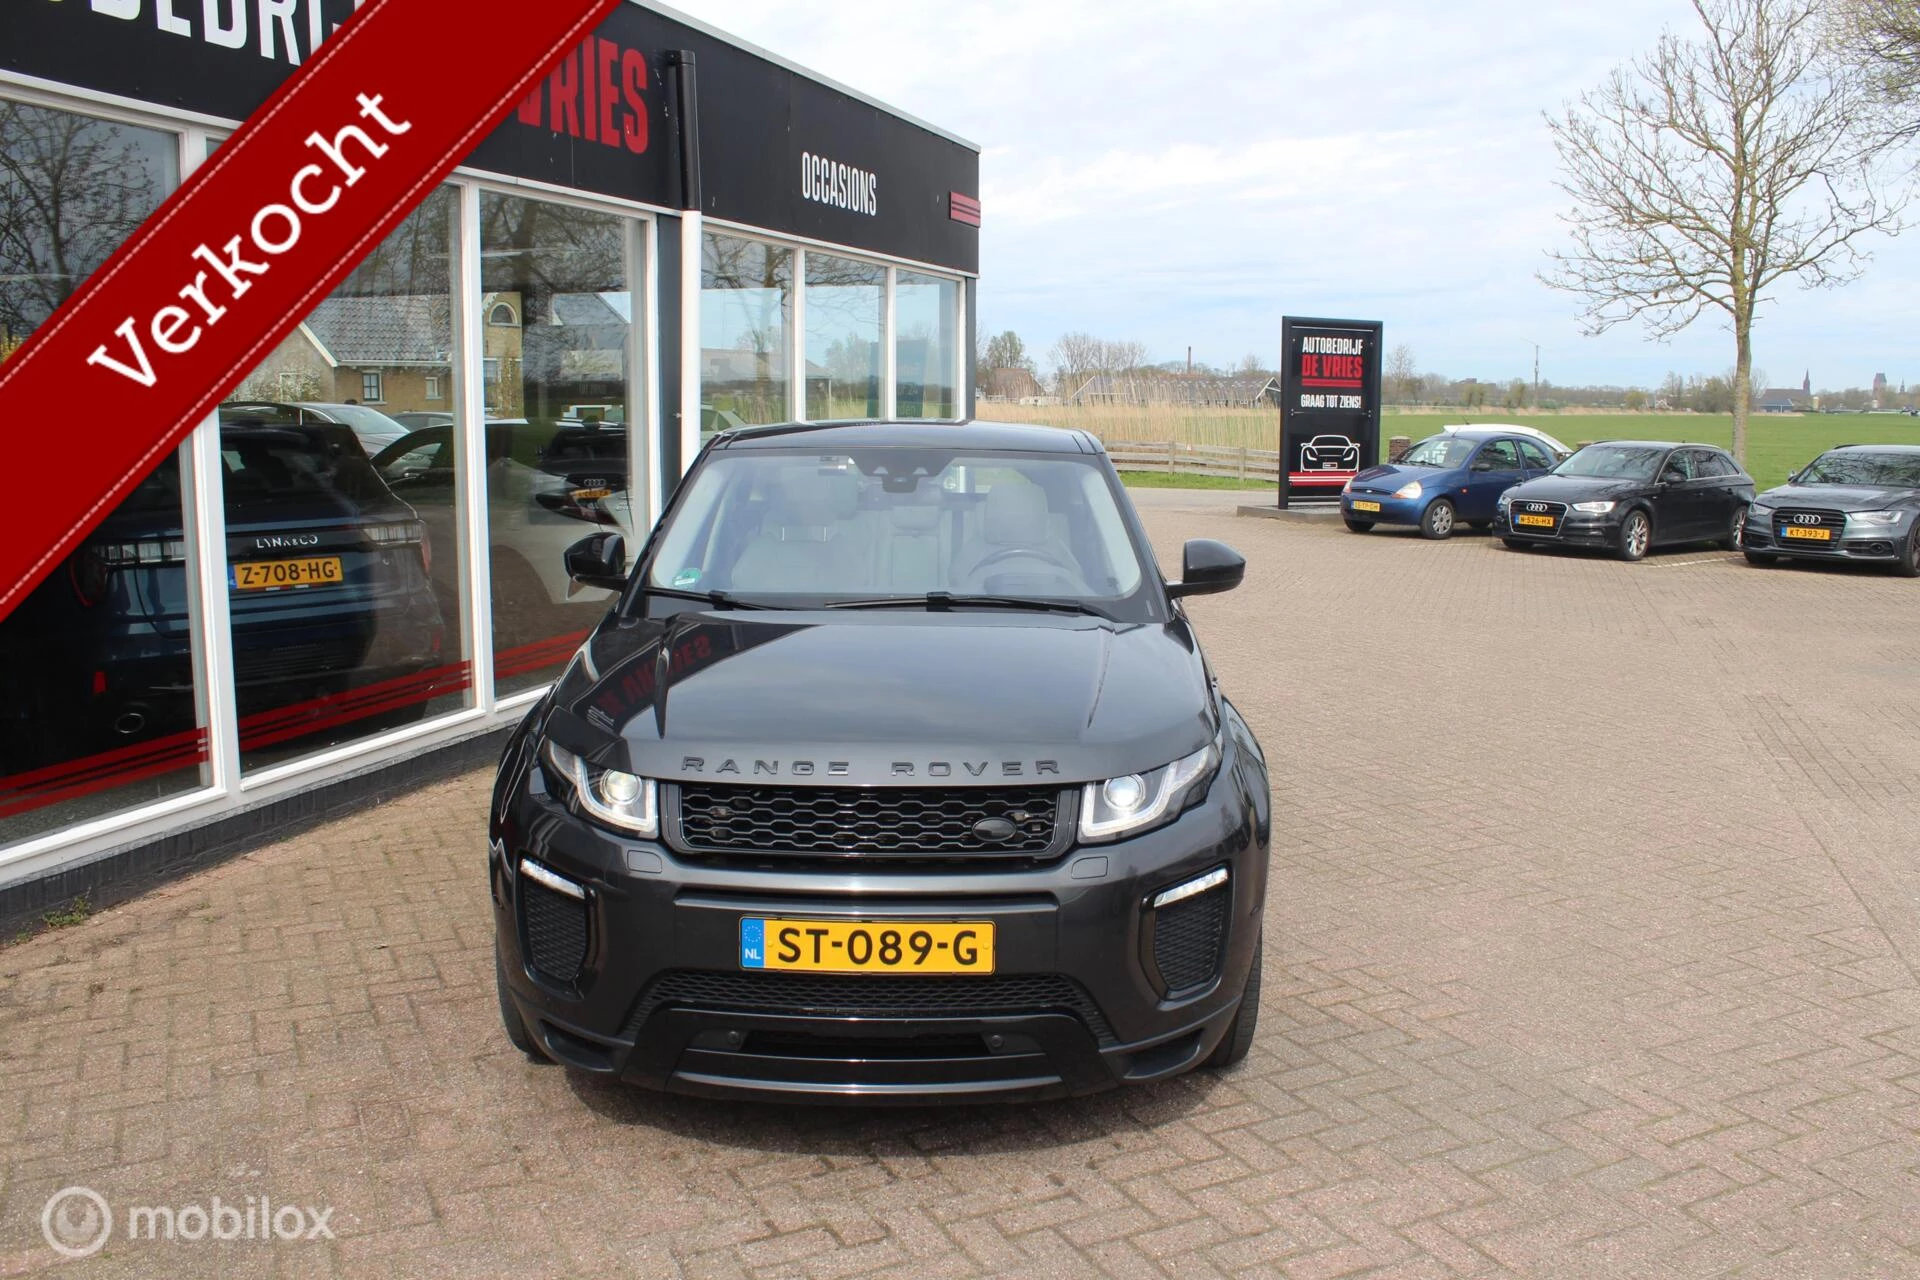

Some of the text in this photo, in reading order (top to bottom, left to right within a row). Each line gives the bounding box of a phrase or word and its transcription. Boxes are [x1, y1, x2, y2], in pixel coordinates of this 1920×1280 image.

[802, 151, 877, 216] OCCASIONS
[1302, 336, 1363, 356] AUTOBEDRIJF
[1302, 355, 1363, 379] DE VRIES
[1301, 394, 1362, 409] GRAAG TOT ZIENS!
[242, 560, 335, 585] Z-708-HG
[681, 756, 1060, 777] RANGE ROVER
[745, 927, 978, 966] NL ST-089-G
